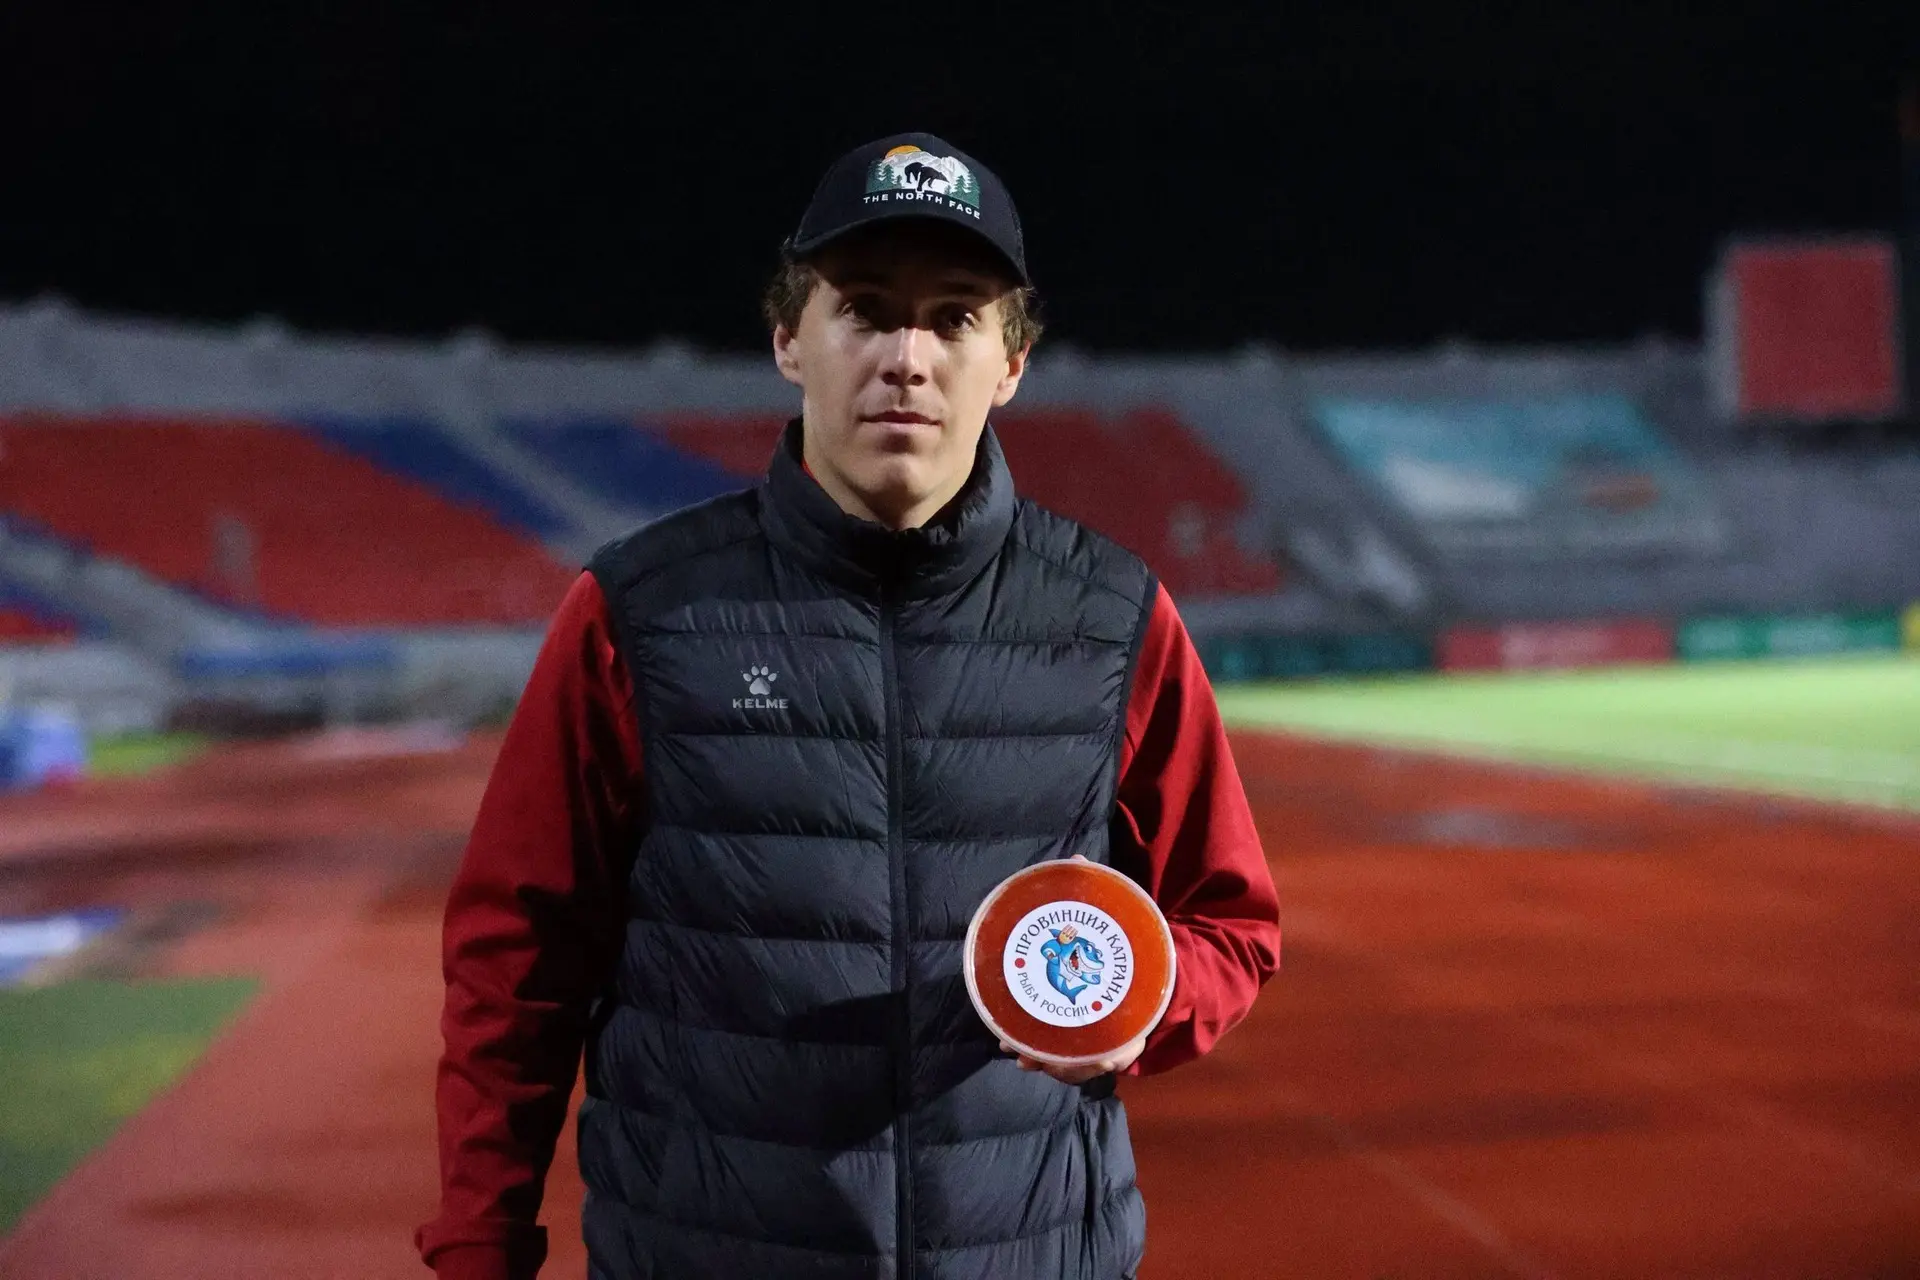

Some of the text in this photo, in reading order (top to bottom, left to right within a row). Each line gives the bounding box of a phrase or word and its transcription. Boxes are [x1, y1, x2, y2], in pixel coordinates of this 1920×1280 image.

[863, 191, 981, 220] THE NORTH FACE
[732, 698, 789, 709] KELME
[1015, 909, 1127, 1003] ПРОВИНЦИЯ КАТРАНА
[1017, 971, 1090, 1017] РЫБА РОССИИ
